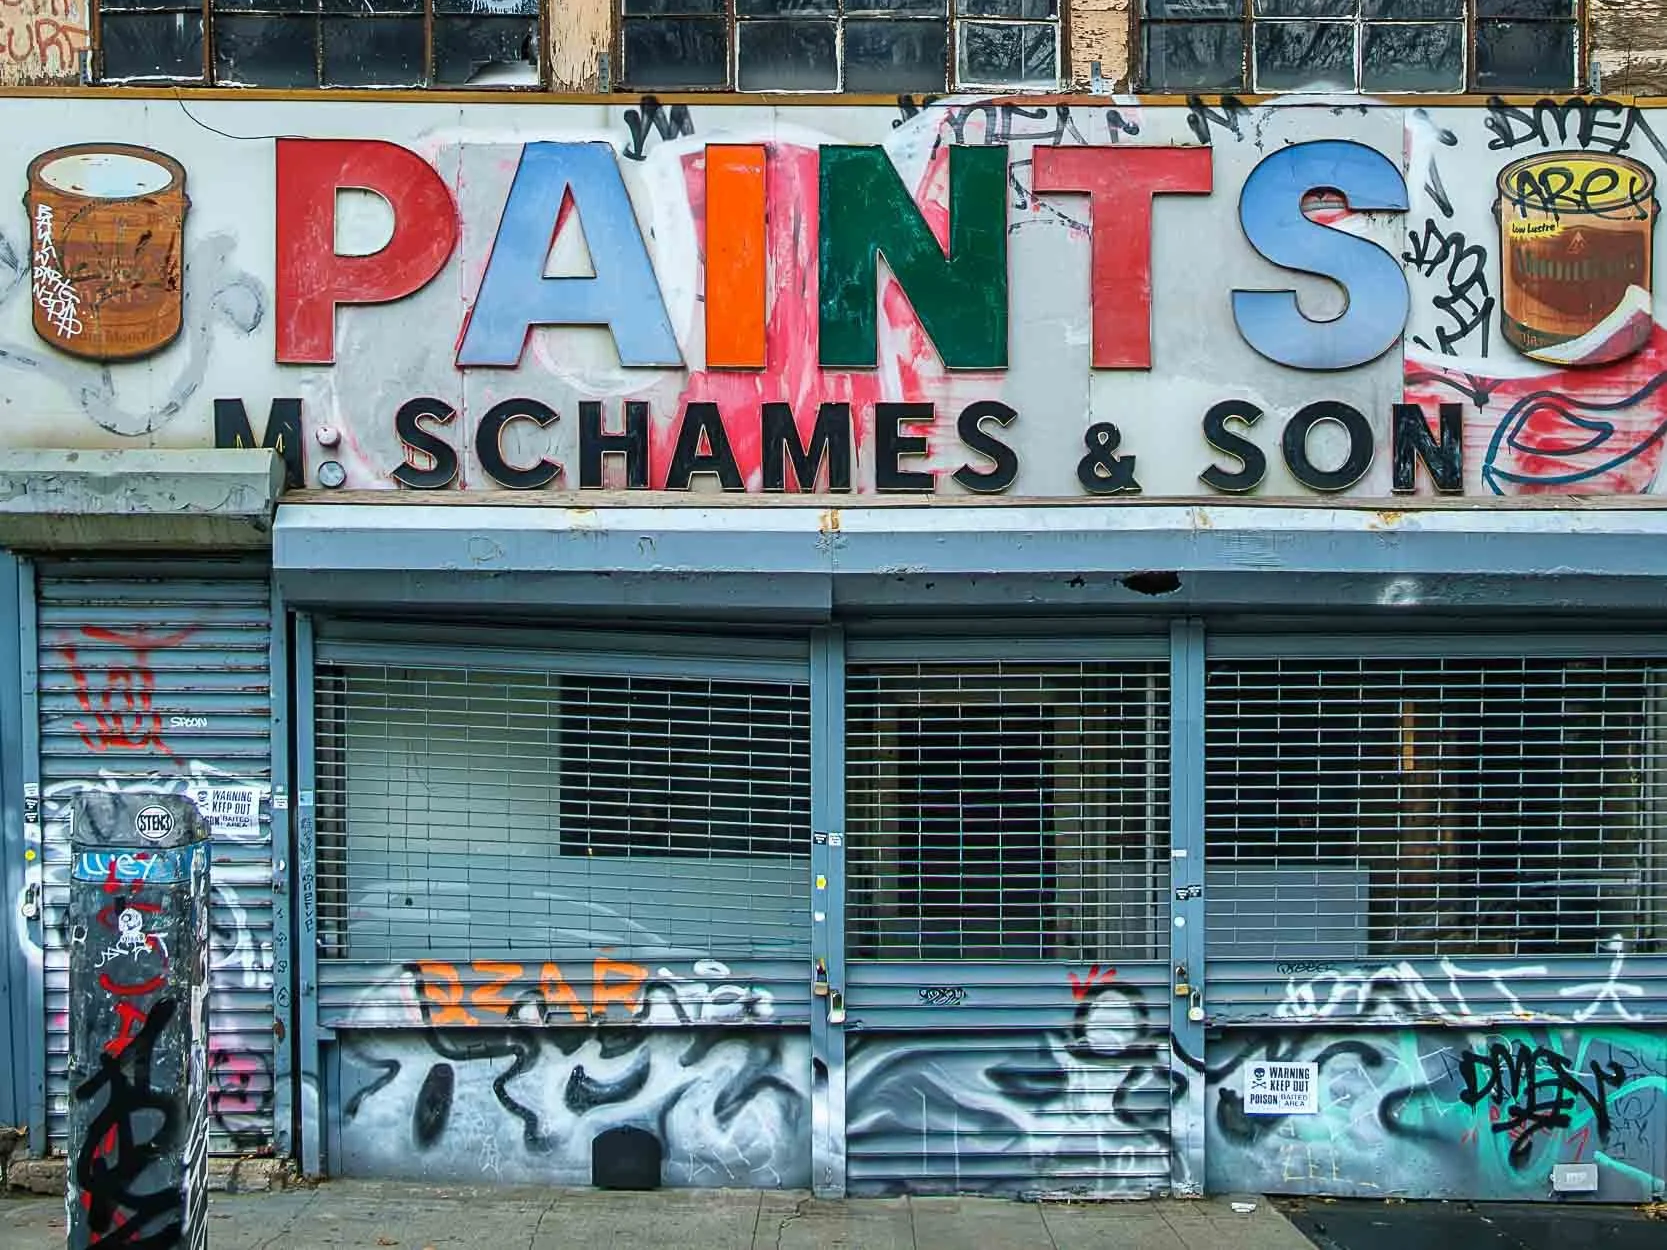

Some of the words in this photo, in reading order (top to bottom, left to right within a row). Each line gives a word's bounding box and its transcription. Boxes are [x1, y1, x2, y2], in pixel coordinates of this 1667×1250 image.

[276, 137, 1410, 371] PAINTS
[392, 397, 1018, 493] SCHAMES
[1077, 422, 1143, 493] &
[1200, 400, 1463, 493] SON
[212, 790, 253, 803] WARNING
[212, 802, 232, 814] KEEP
[234, 803, 251, 815] OUT
[1269, 1066, 1310, 1080] WARNING
[1270, 1080, 1291, 1092] KEEP
[1293, 1080, 1309, 1093] OUT
[1250, 1093, 1278, 1105] POISON
[1280, 1093, 1308, 1101] BAITED
[1284, 1100, 1305, 1108] AREA
